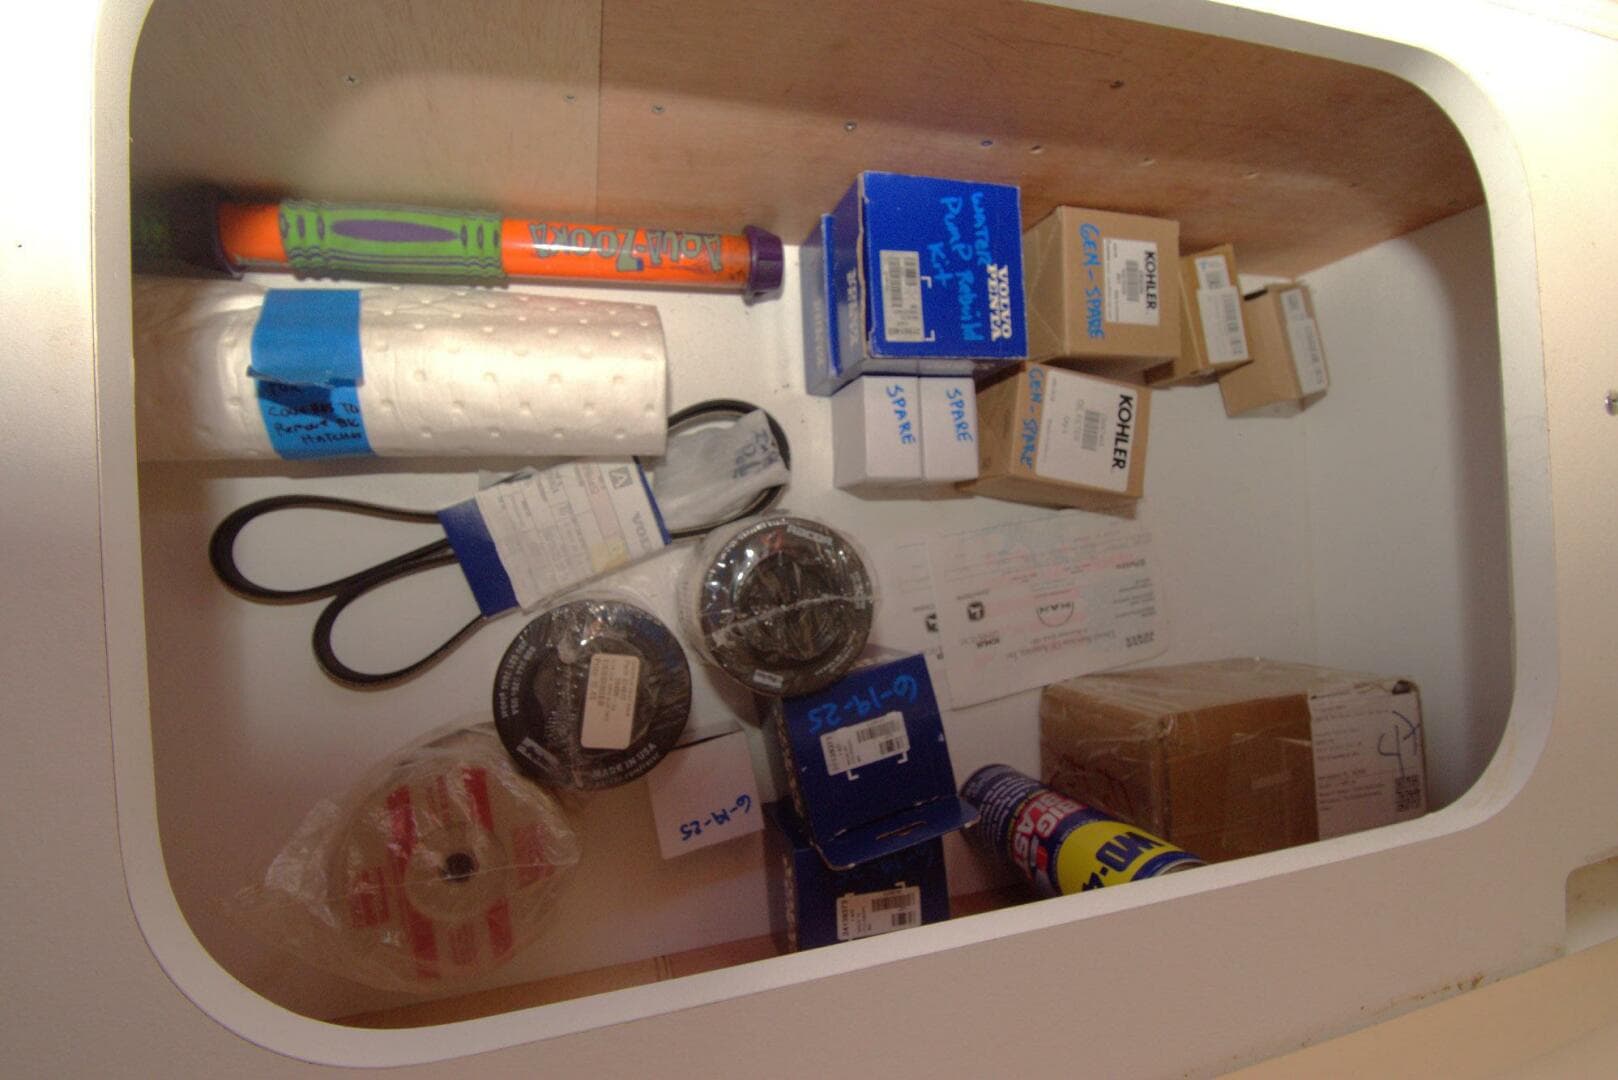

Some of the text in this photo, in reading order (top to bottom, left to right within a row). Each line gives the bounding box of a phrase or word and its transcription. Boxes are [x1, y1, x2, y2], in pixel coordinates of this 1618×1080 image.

[528, 223, 723, 273] AQUA-ZOOKA
[927, 242, 953, 289] Kit
[986, 263, 1000, 342] PENTA
[998, 265, 1012, 339] VOLVO
[1145, 250, 1157, 310] KOHLER
[1085, 287, 1105, 339] SPARE
[886, 384, 916, 445] SPARE
[946, 387, 974, 443] SPARE
[1111, 394, 1134, 470] KOHLER
[1019, 419, 1039, 471] SPARE
[806, 674, 918, 734] 6-19-25
[679, 795, 752, 842] 6-19-25
[1034, 799, 1080, 838] BIG
[1081, 832, 1164, 892] WD-4
